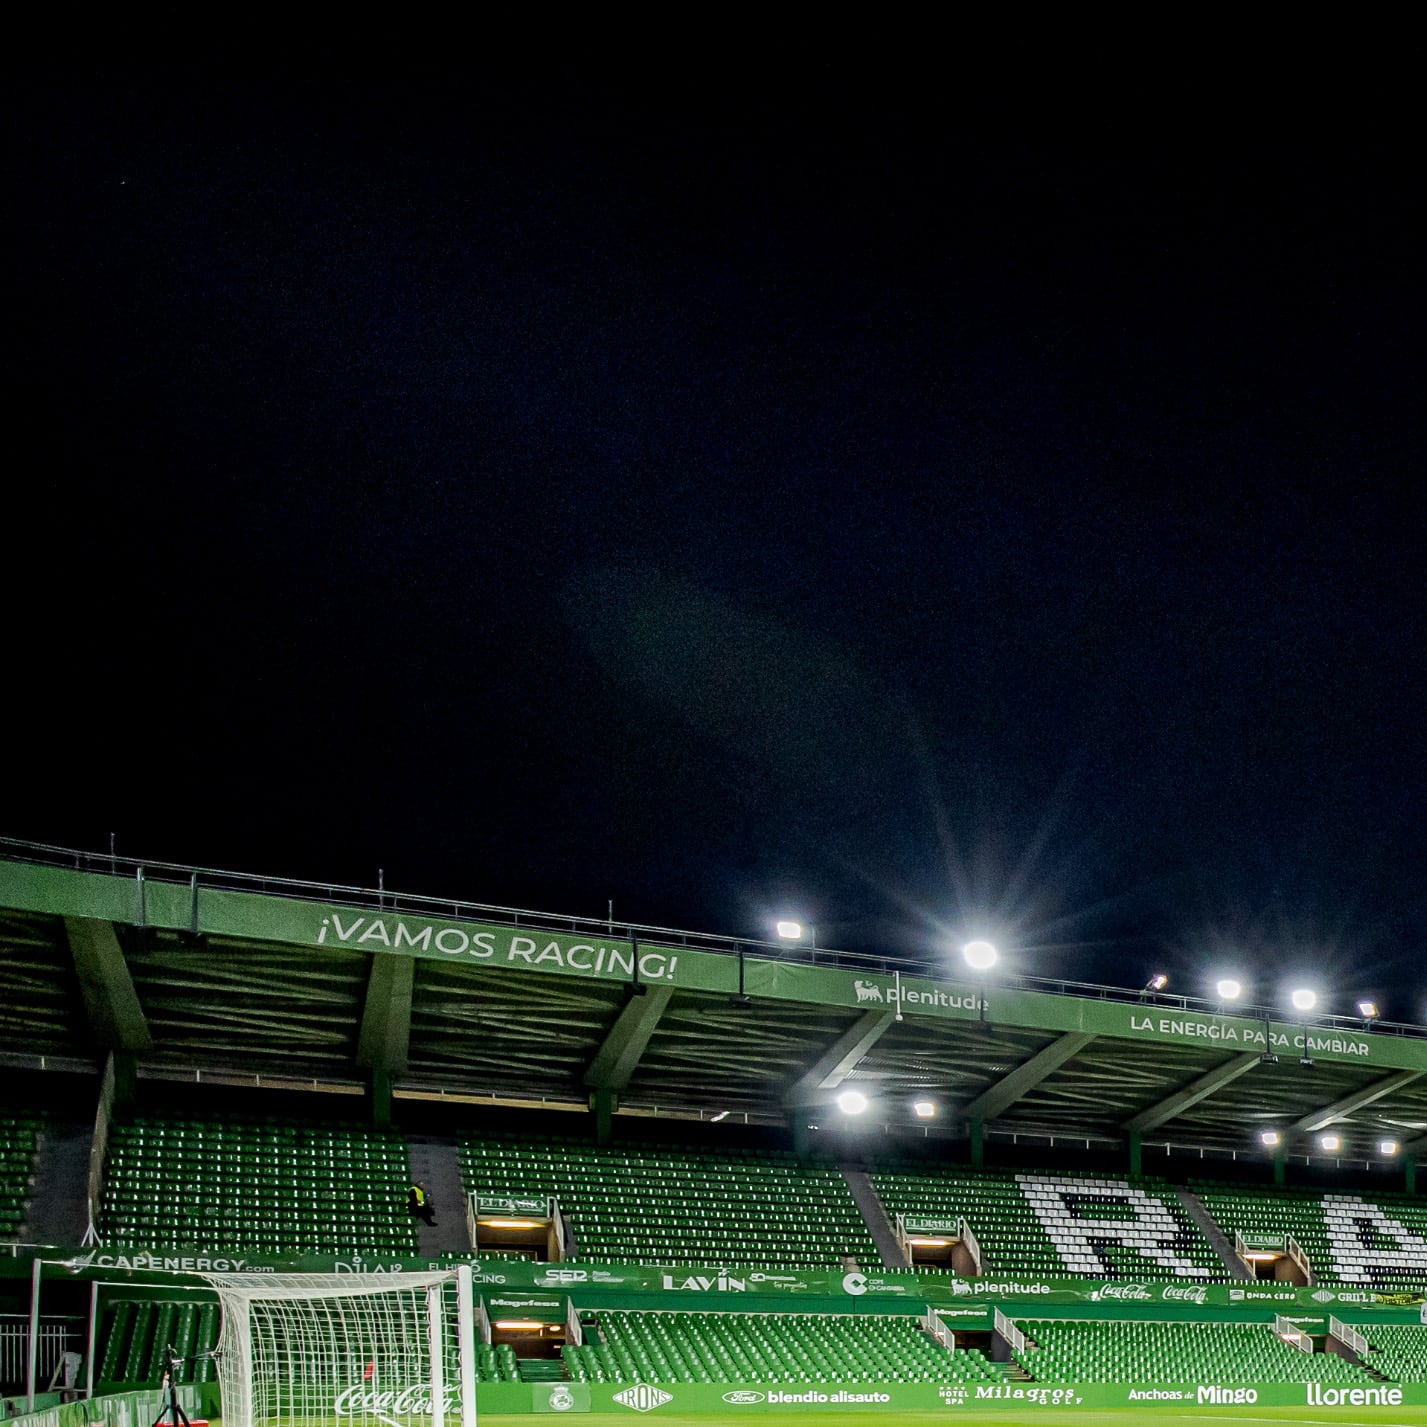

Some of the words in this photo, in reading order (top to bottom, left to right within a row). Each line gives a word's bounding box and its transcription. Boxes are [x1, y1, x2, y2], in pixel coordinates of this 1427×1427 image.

[317, 914, 495, 958] ¡VAMOS
[508, 936, 678, 980] RACING!
[886, 986, 989, 1011] plenitude
[1130, 1016, 1154, 1031] LA
[1159, 1019, 1238, 1041] ENERGÍA
[1243, 1030, 1289, 1047] PARA
[1294, 1035, 1369, 1056] CAMBIAR
[906, 1218, 923, 1228] EL
[924, 1219, 957, 1230] DIARIO
[1243, 1234, 1254, 1243] EL
[1255, 1235, 1284, 1245] DIARIO
[663, 1268, 746, 1292] LAVÍN
[975, 1281, 1051, 1295] plenitude
[1099, 1283, 1152, 1299] Coca-Cola
[1162, 1284, 1207, 1301] Coca-Cola
[1247, 1292, 1273, 1300] ONDA
[1274, 1292, 1296, 1300] CERO
[490, 1298, 560, 1308] Magefesa
[614, 1383, 672, 1412] IRONS
[731, 1392, 757, 1402] Ford
[768, 1391, 828, 1403] blendio
[830, 1391, 890, 1403] alisauto
[975, 1386, 1075, 1402] Milagros
[1128, 1388, 1183, 1400] Anchoas
[1197, 1385, 1258, 1404] Mingo
[1306, 1383, 1402, 1406] llorente
